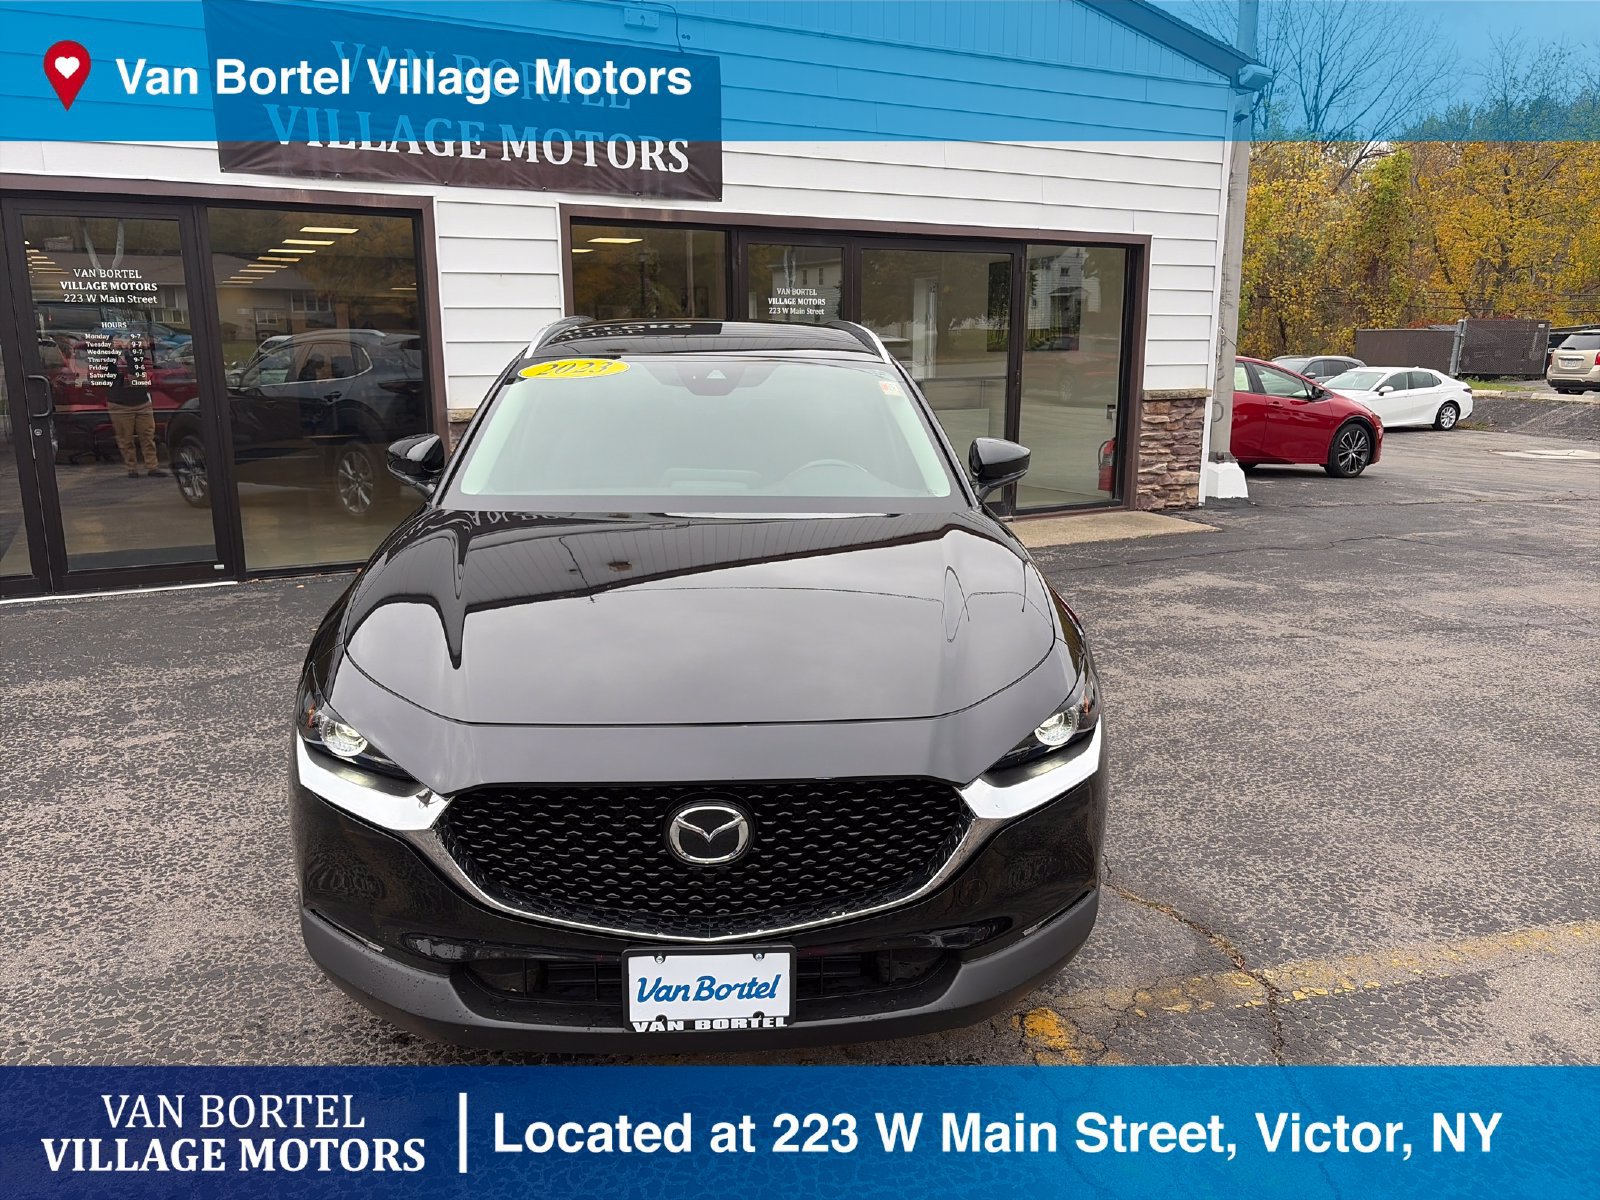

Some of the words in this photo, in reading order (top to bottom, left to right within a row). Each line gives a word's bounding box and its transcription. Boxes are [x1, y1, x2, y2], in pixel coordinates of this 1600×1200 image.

[262, 103, 487, 160] VILLAGE
[499, 123, 690, 173] MOTORS
[73, 268, 96, 278] VAN
[100, 269, 142, 279] BORTEL
[60, 281, 108, 290] VILLAGE
[109, 282, 158, 291] MOTORS
[791, 288, 817, 296] BORTEL
[64, 294, 83, 303] 223
[86, 294, 97, 303] W
[100, 294, 125, 303] Main
[127, 295, 158, 303] Street
[768, 297, 796, 305] VILLAGE
[797, 298, 826, 306] MOTORS
[535, 361, 613, 376] 2023
[637, 976, 691, 1003] Van
[692, 974, 781, 1002] Bortel
[632, 1020, 685, 1033] VAN
[694, 1017, 788, 1031] BORTEL
